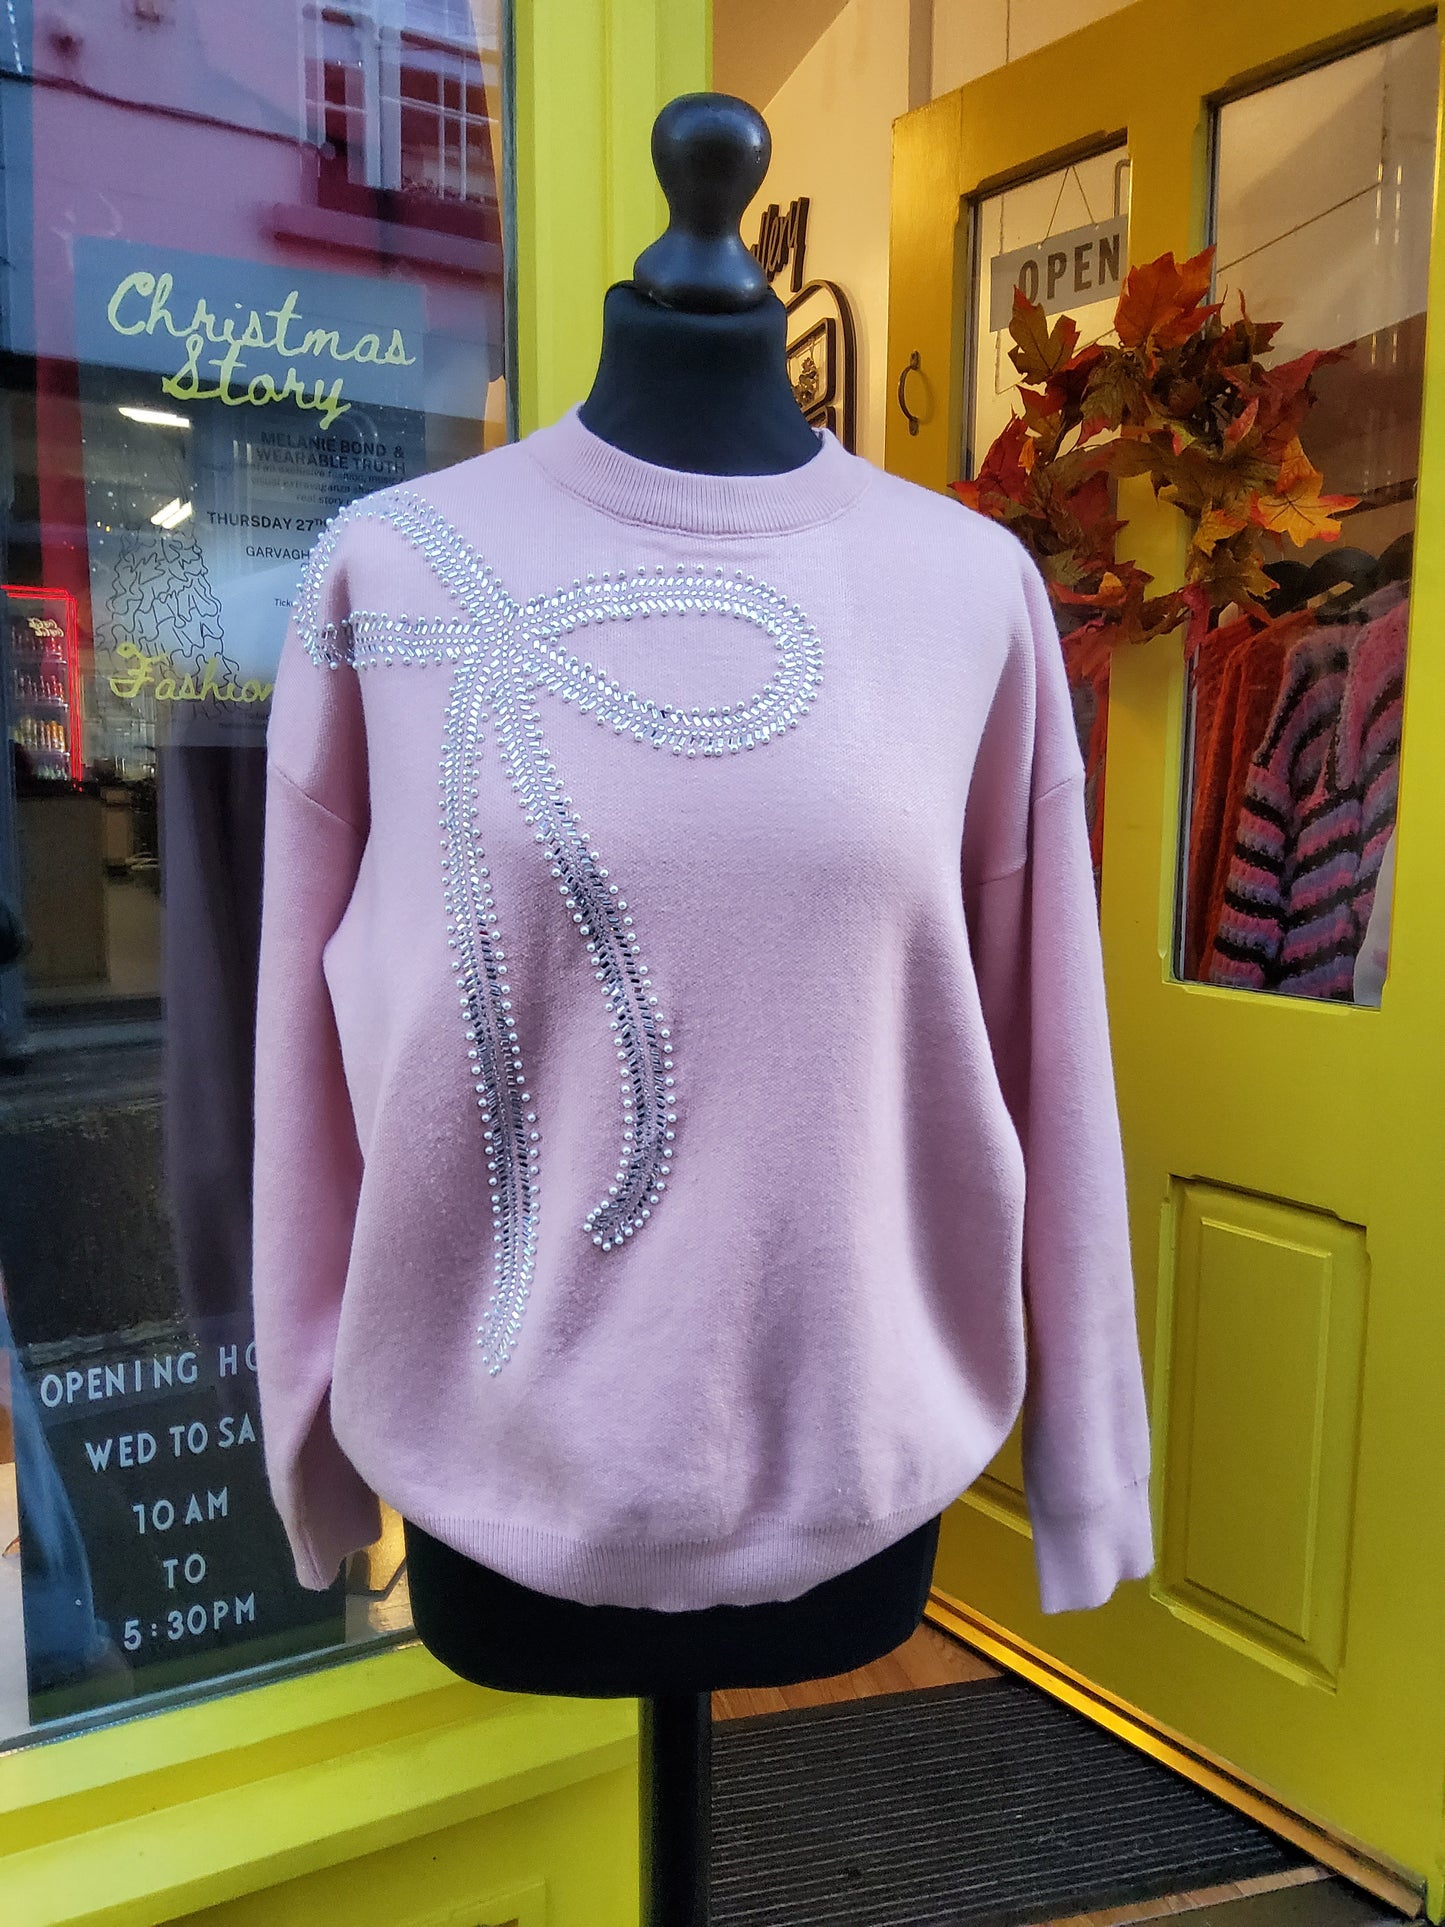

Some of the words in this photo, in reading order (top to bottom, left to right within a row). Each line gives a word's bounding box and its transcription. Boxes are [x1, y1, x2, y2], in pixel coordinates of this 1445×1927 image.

[1018, 233, 1121, 305] OPEN
[107, 271, 416, 366] Christmas
[162, 333, 352, 430] Story
[256, 448, 349, 470] WEARABLE
[353, 457, 406, 476] TRUTH
[260, 431, 337, 453] MELANIE
[340, 439, 387, 457] BOND
[393, 445, 405, 459] &
[207, 511, 292, 531] THURSDAY
[40, 1351, 198, 1408] OPENING
[85, 1432, 157, 1474] WED
[169, 1422, 209, 1458] TO
[217, 1412, 256, 1449] SA
[163, 1553, 207, 1589] TO
[123, 1592, 255, 1651] 5:30PM
